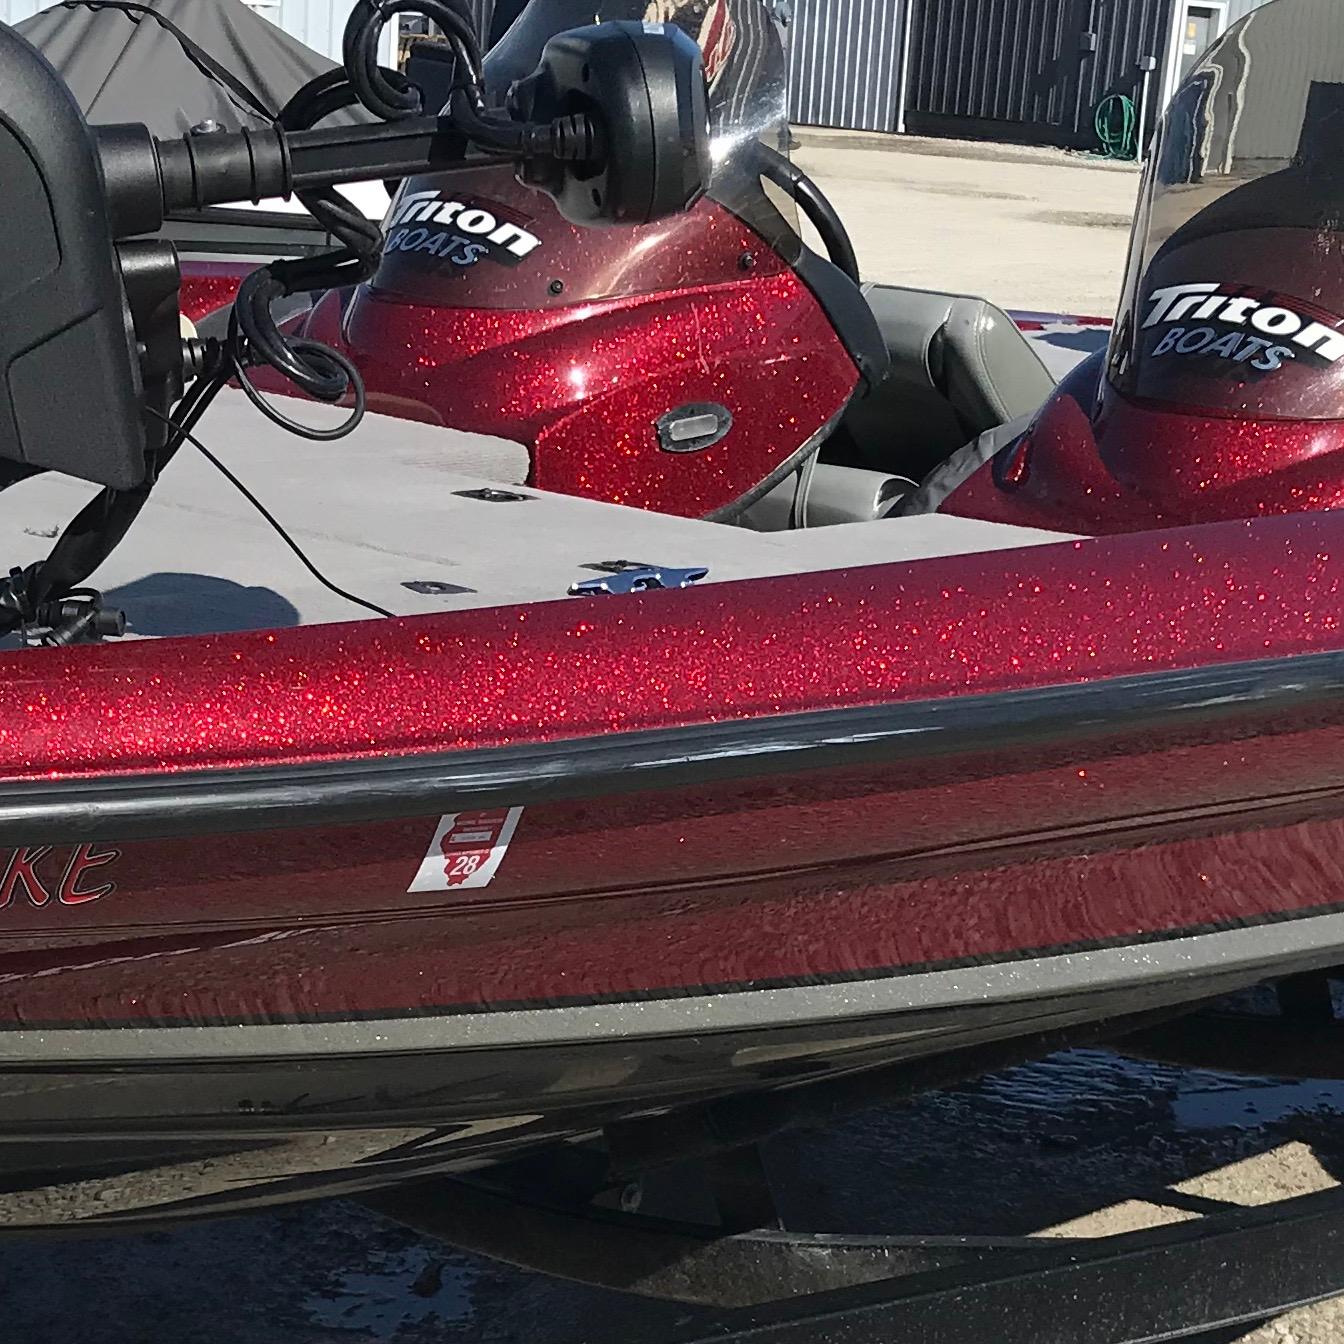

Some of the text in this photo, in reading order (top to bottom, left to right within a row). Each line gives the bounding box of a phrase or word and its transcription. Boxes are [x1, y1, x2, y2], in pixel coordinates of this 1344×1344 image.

[385, 227, 490, 266] BOATS
[1151, 327, 1296, 371] BOATS
[449, 855, 481, 877] 28
